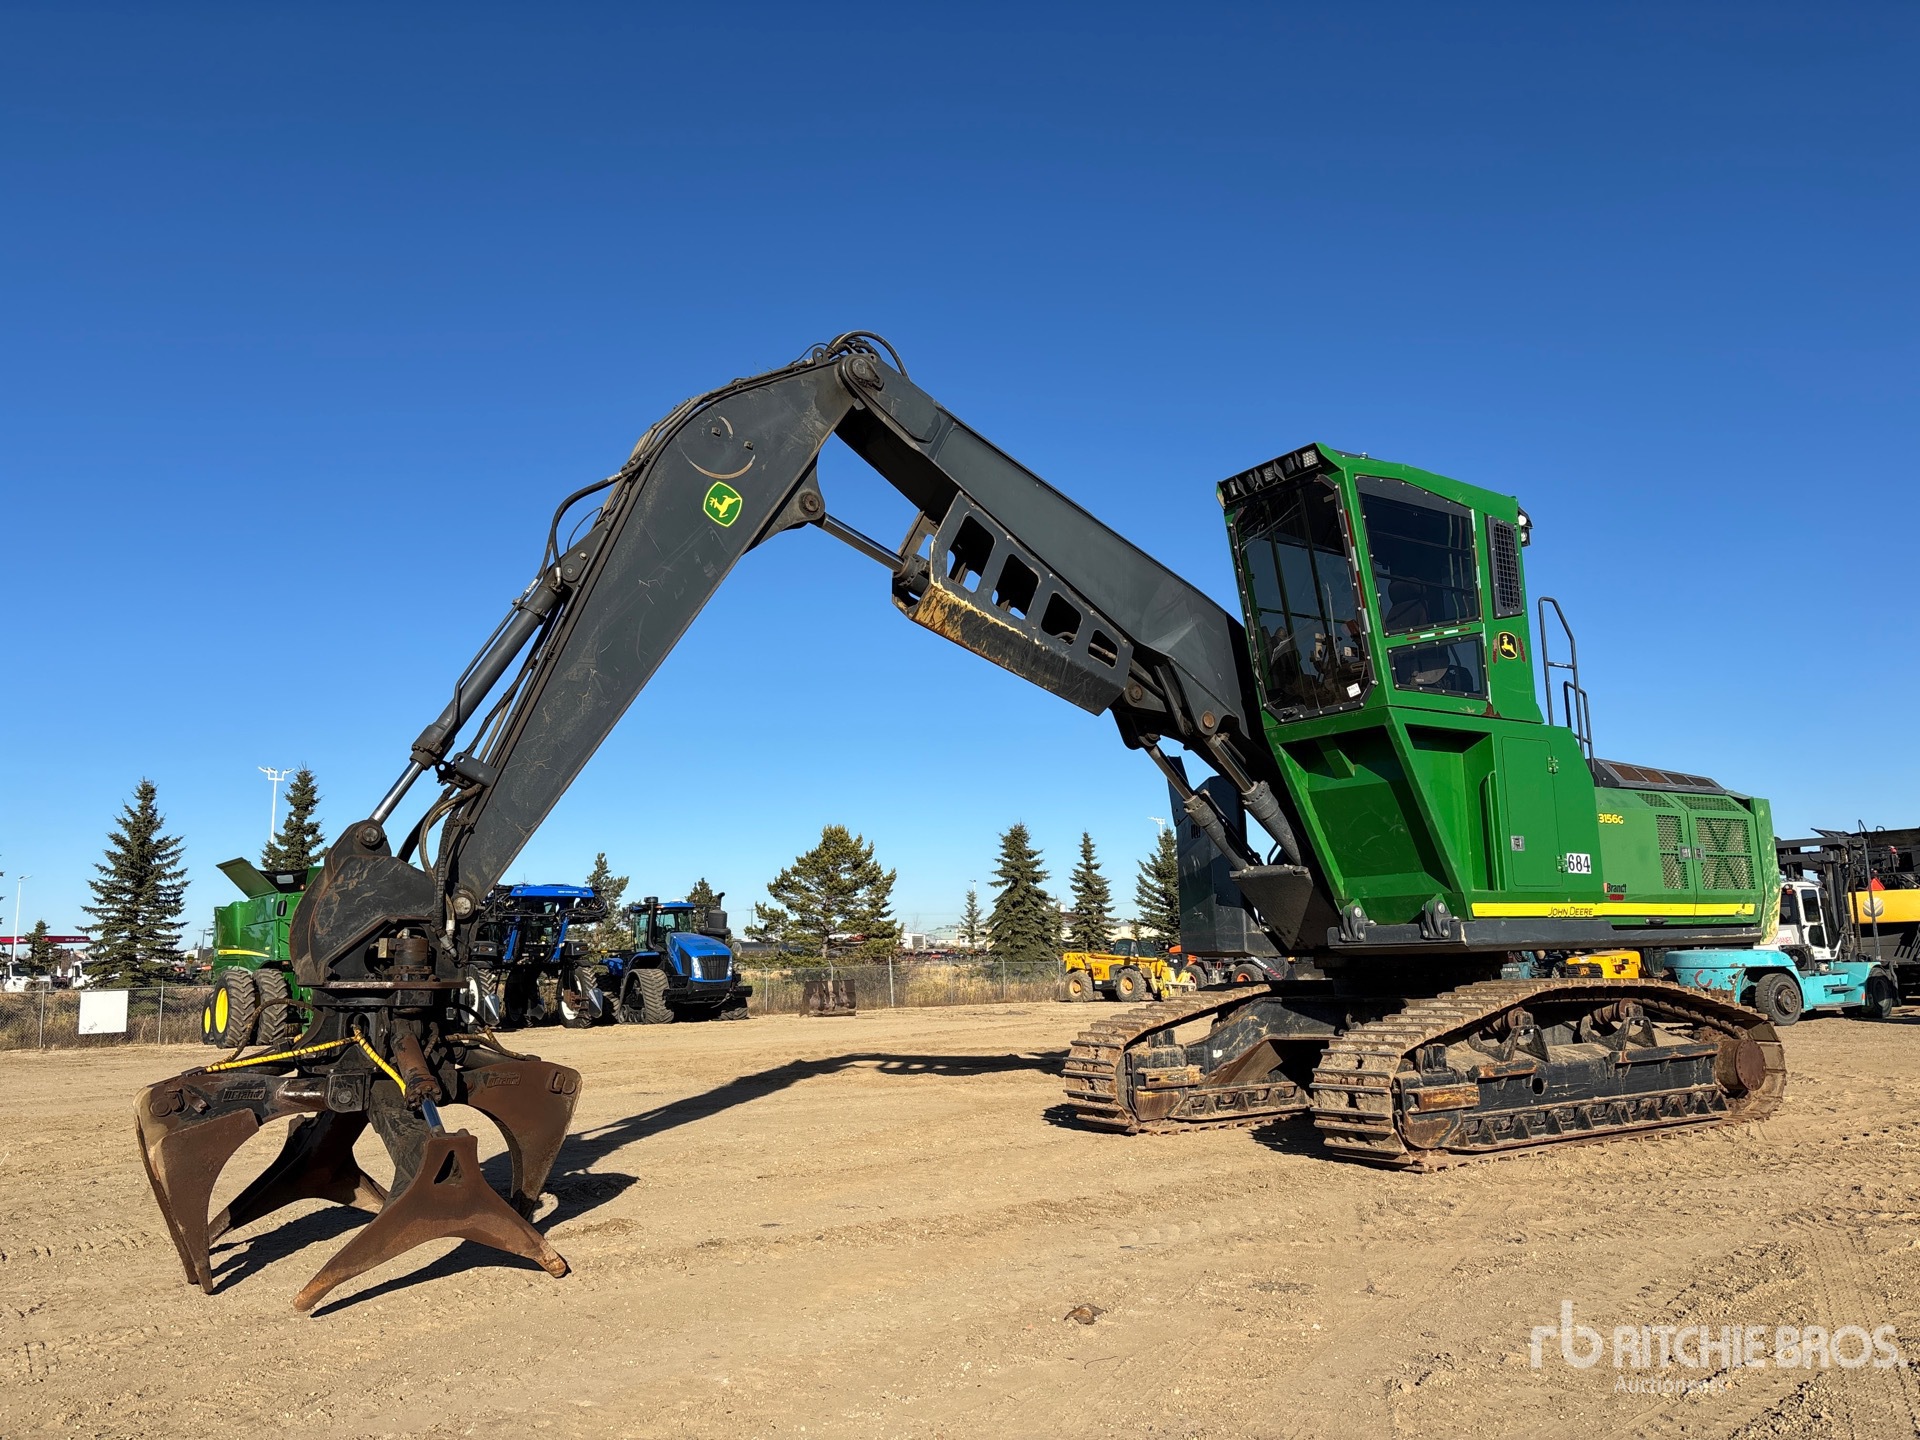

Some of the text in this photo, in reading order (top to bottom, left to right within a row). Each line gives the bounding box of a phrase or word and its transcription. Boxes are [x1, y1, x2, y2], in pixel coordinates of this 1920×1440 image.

[1598, 813, 1624, 825] 3156G
[1568, 854, 1590, 873] 684
[1606, 882, 1627, 893] Brandt
[1548, 906, 1594, 916] JOHN DEERE
